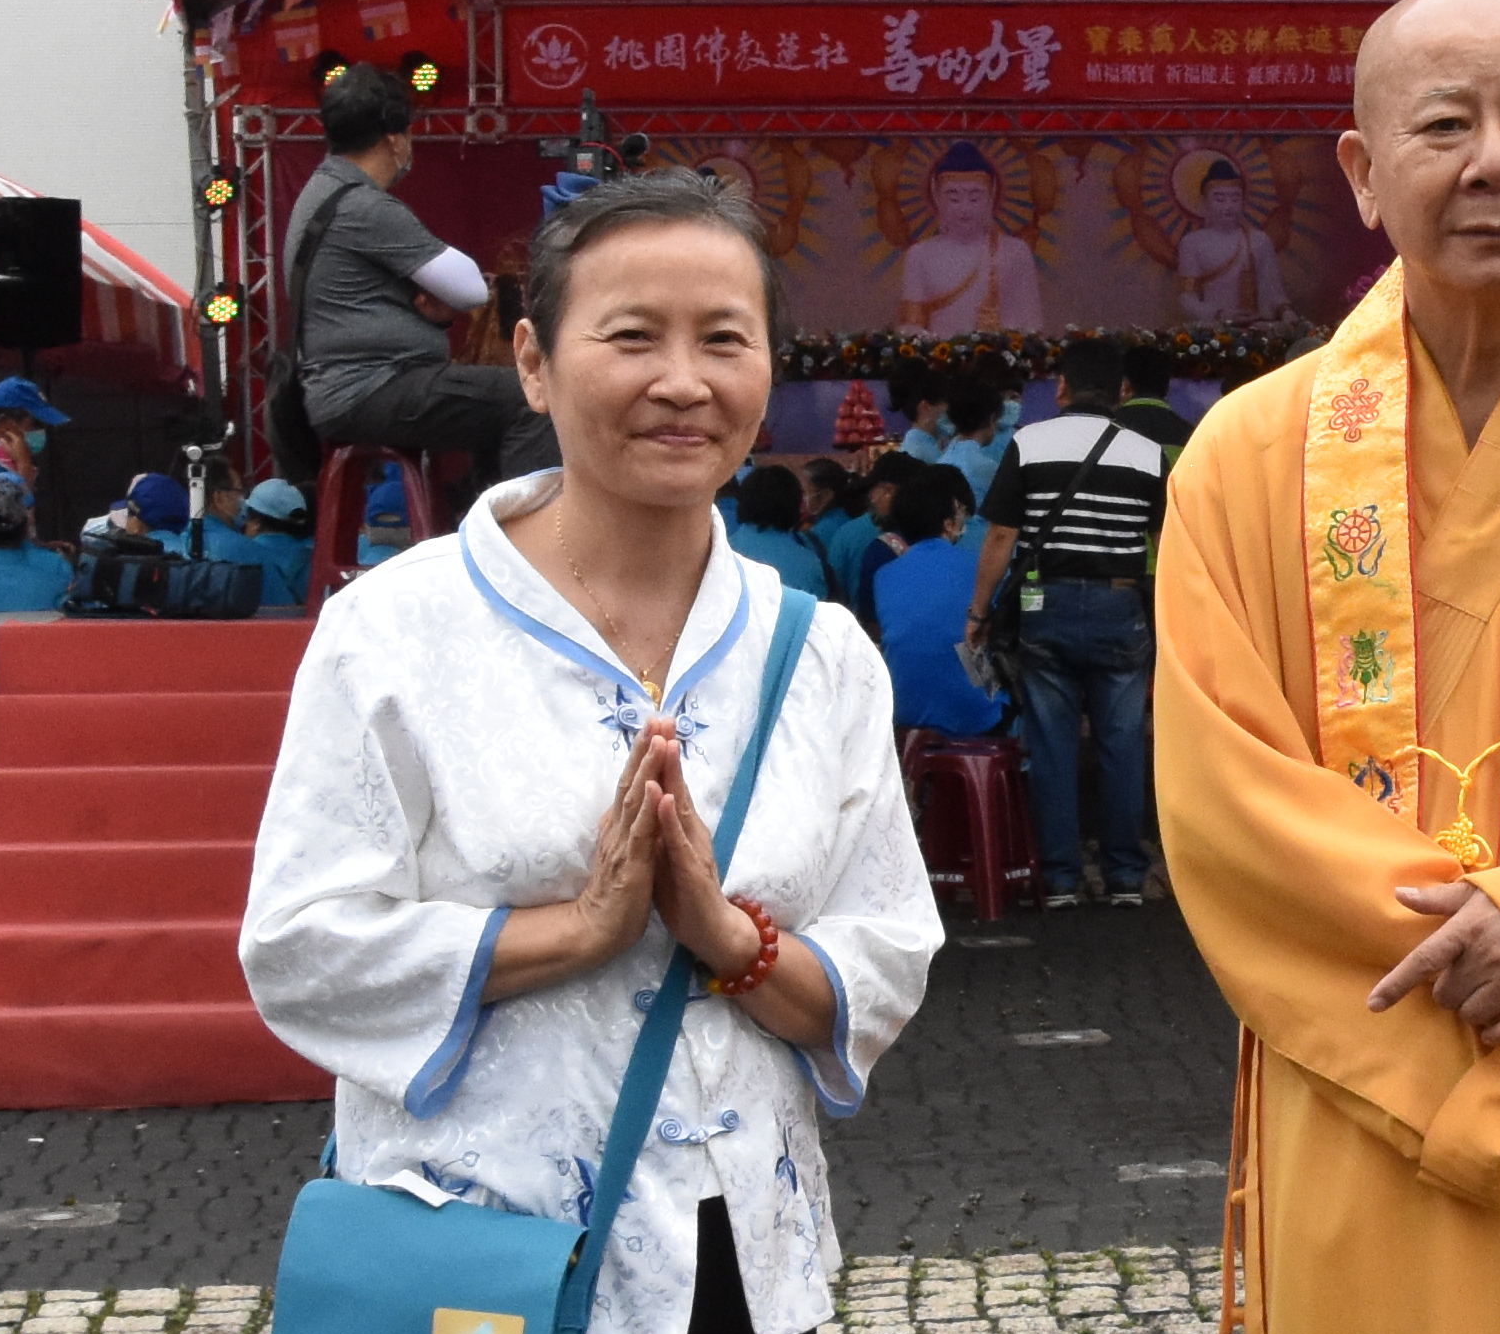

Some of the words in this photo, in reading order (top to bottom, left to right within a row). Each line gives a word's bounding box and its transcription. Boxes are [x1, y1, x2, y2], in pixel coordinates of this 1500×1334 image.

[603, 26, 849, 85] 桃園佛教蓮社
[860, 9, 1062, 94] 善的力量
